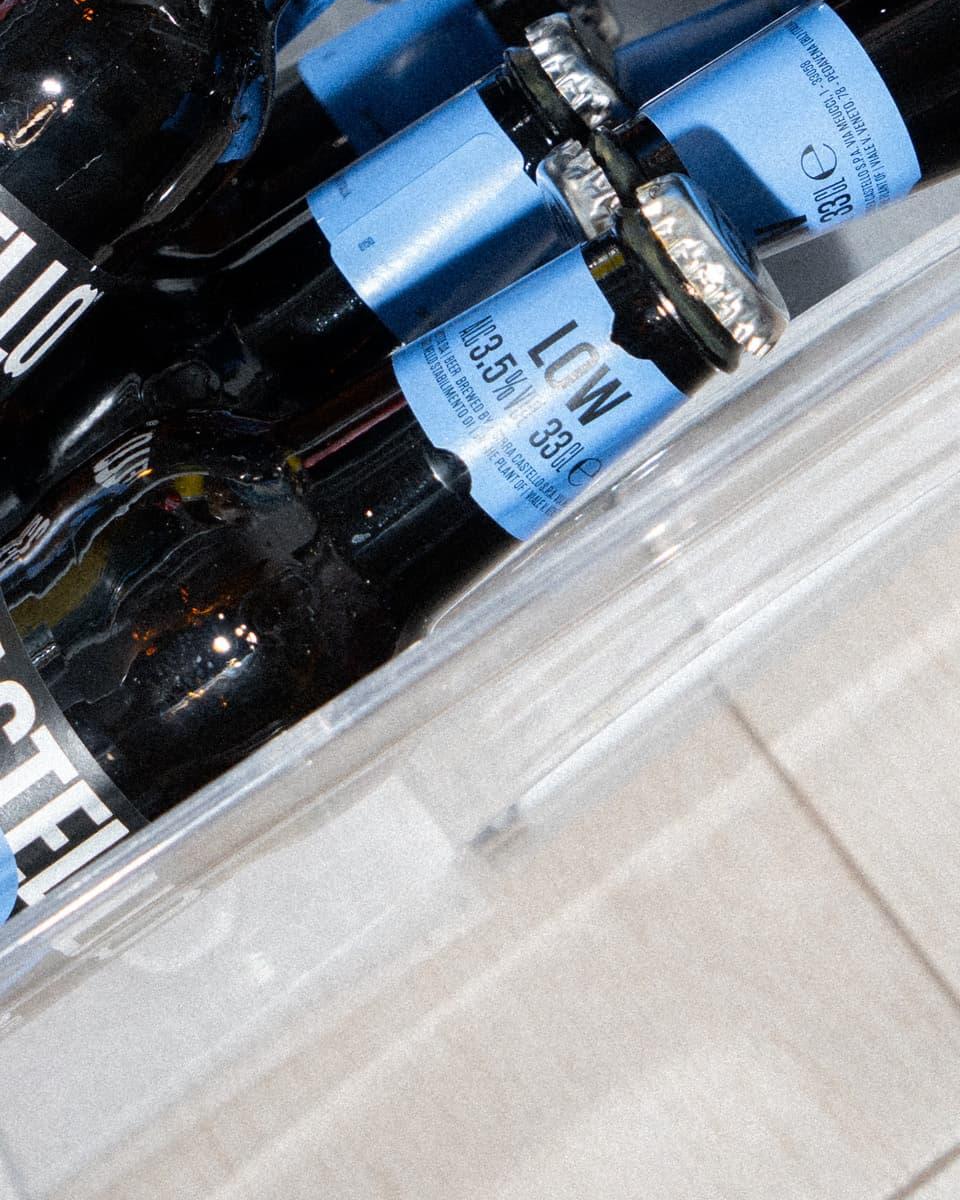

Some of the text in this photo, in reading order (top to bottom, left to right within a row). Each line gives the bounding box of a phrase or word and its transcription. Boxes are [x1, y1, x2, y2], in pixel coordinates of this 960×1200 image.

[800, 60, 822, 86] 33058
[806, 43, 839, 82] PEDAVENA
[835, 86, 849, 100] 78
[842, 130, 856, 148] VIA
[863, 144, 881, 168] VIALE
[857, 169, 876, 202] CASTELLO
[527, 319, 634, 430] LOW
[430, 361, 469, 418] STABILIMENTO
[494, 457, 520, 483] PLANT
[513, 479, 528, 491] OF
[444, 355, 461, 376] BEER
[455, 376, 484, 413] BREWED
[477, 410, 493, 423] BY
[511, 454, 545, 488] CASTELLO
